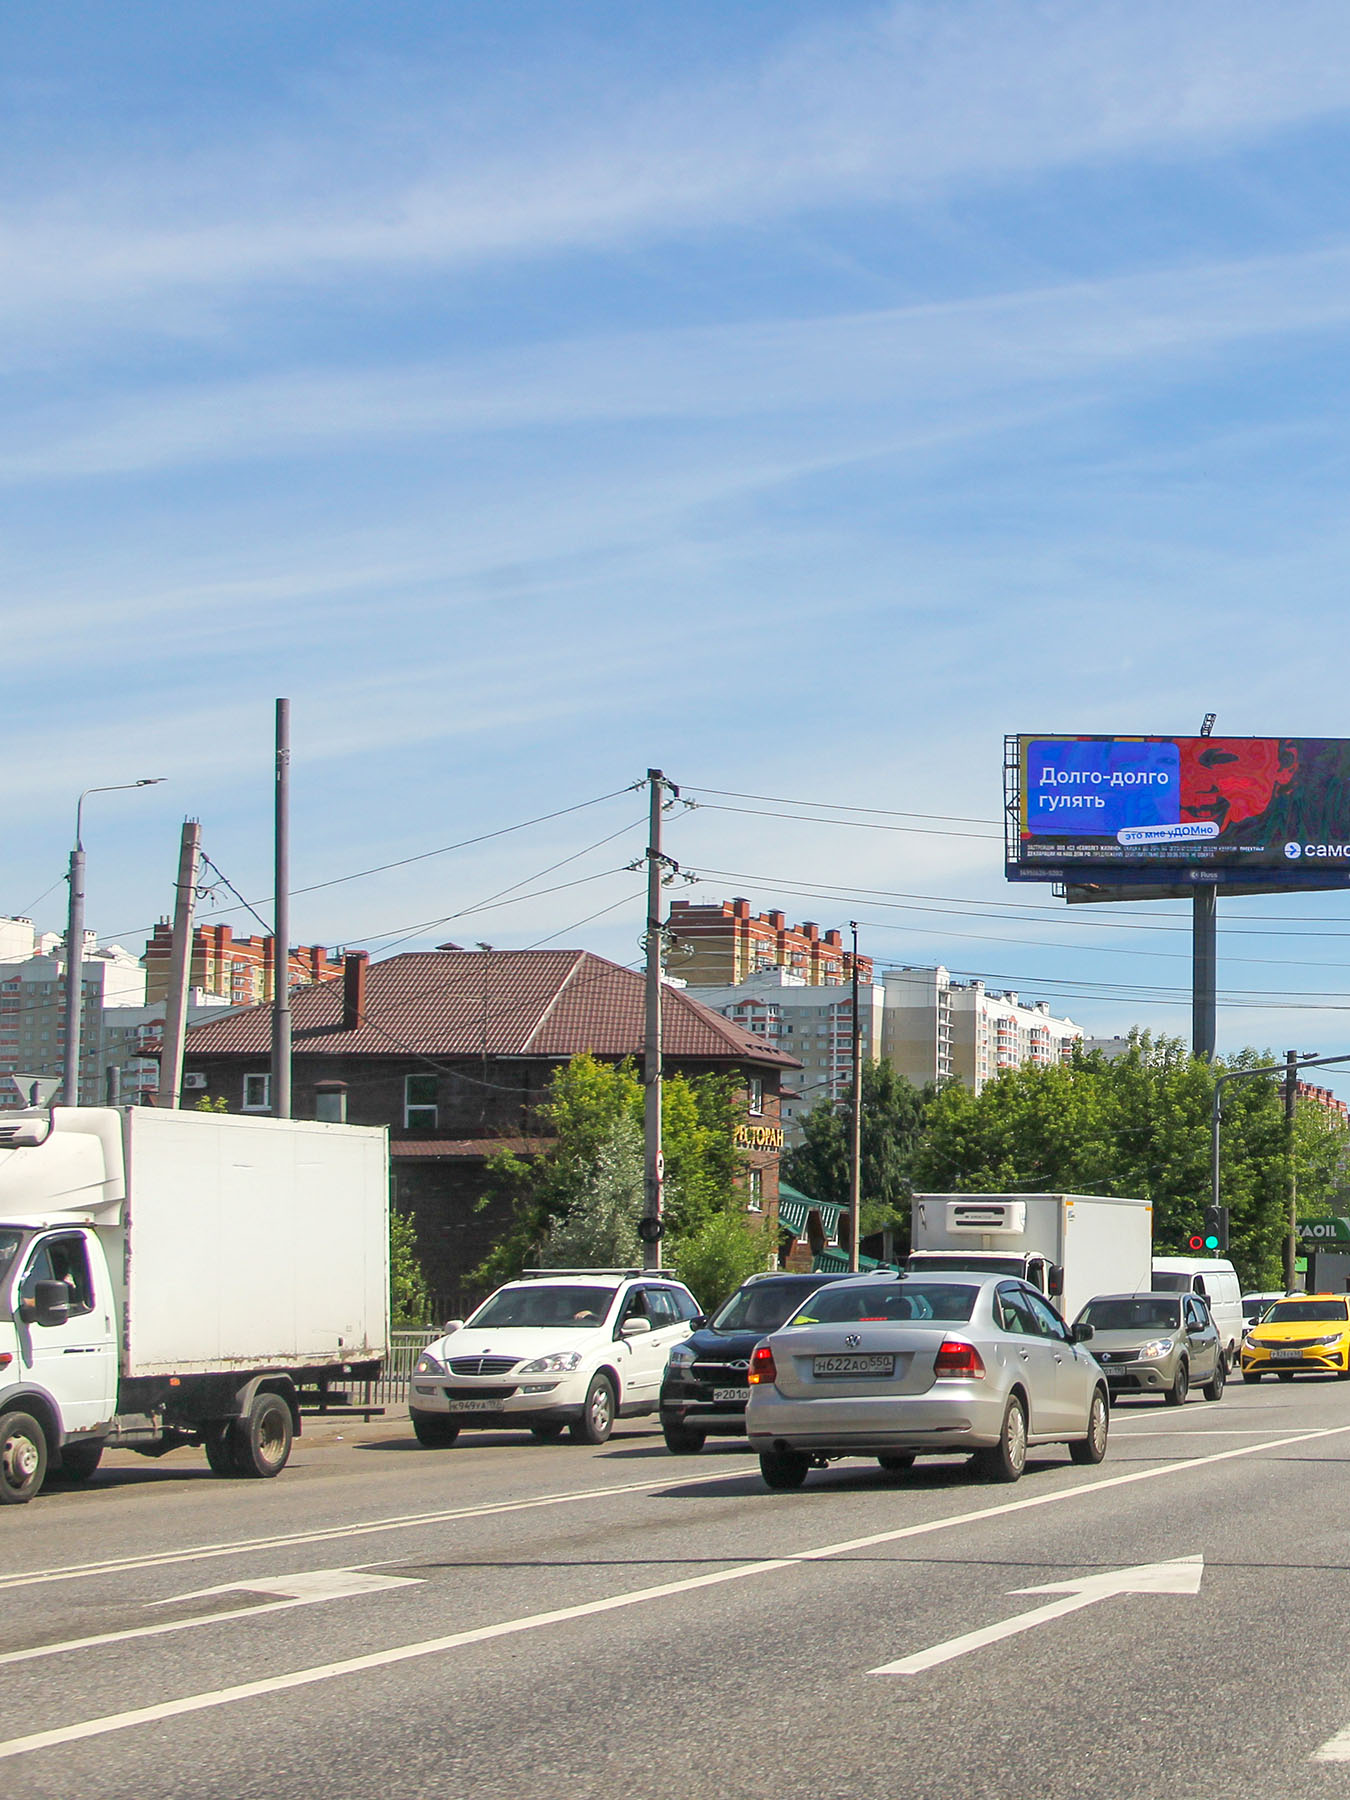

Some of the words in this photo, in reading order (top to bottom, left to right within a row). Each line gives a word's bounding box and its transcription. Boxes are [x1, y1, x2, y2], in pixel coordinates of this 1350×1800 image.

[1039, 767, 1169, 787] Долго-долго
[1039, 795, 1106, 812] гулять
[1124, 832, 1143, 841] это
[1145, 830, 1166, 839] мне
[1167, 825, 1214, 839] уДОМно
[733, 1124, 784, 1148] РЕСТОРАН
[1296, 1224, 1337, 1238] TAOIL
[714, 1390, 748, 1400] Р201О
